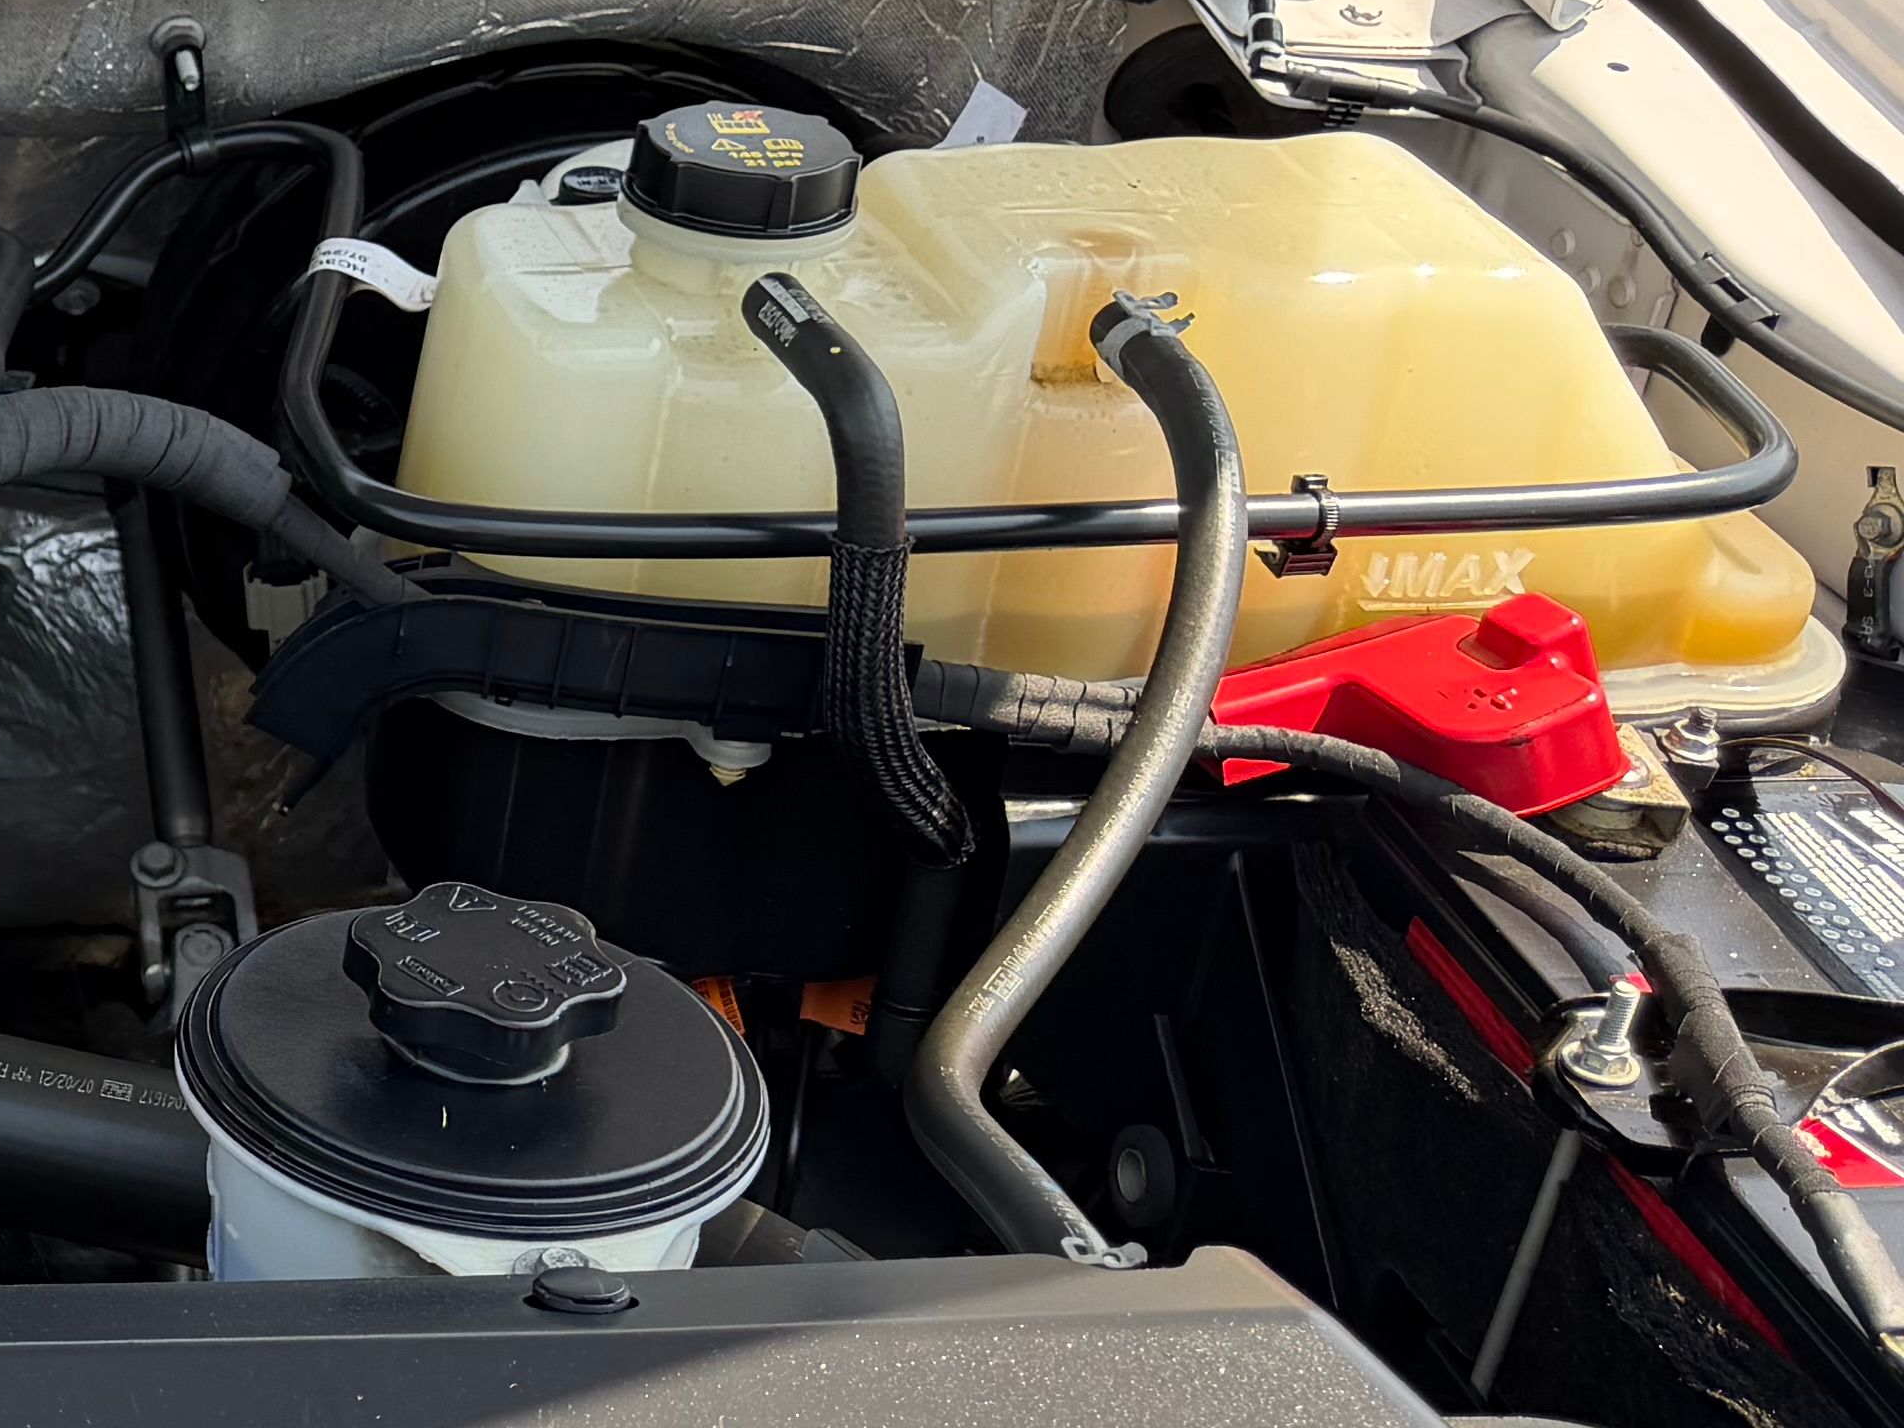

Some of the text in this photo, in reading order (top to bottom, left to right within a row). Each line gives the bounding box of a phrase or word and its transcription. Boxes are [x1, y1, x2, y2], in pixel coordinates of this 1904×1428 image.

[744, 159, 768, 167] 21
[1387, 548, 1537, 598] MAX
[37, 1068, 96, 1094] 07/02/21
